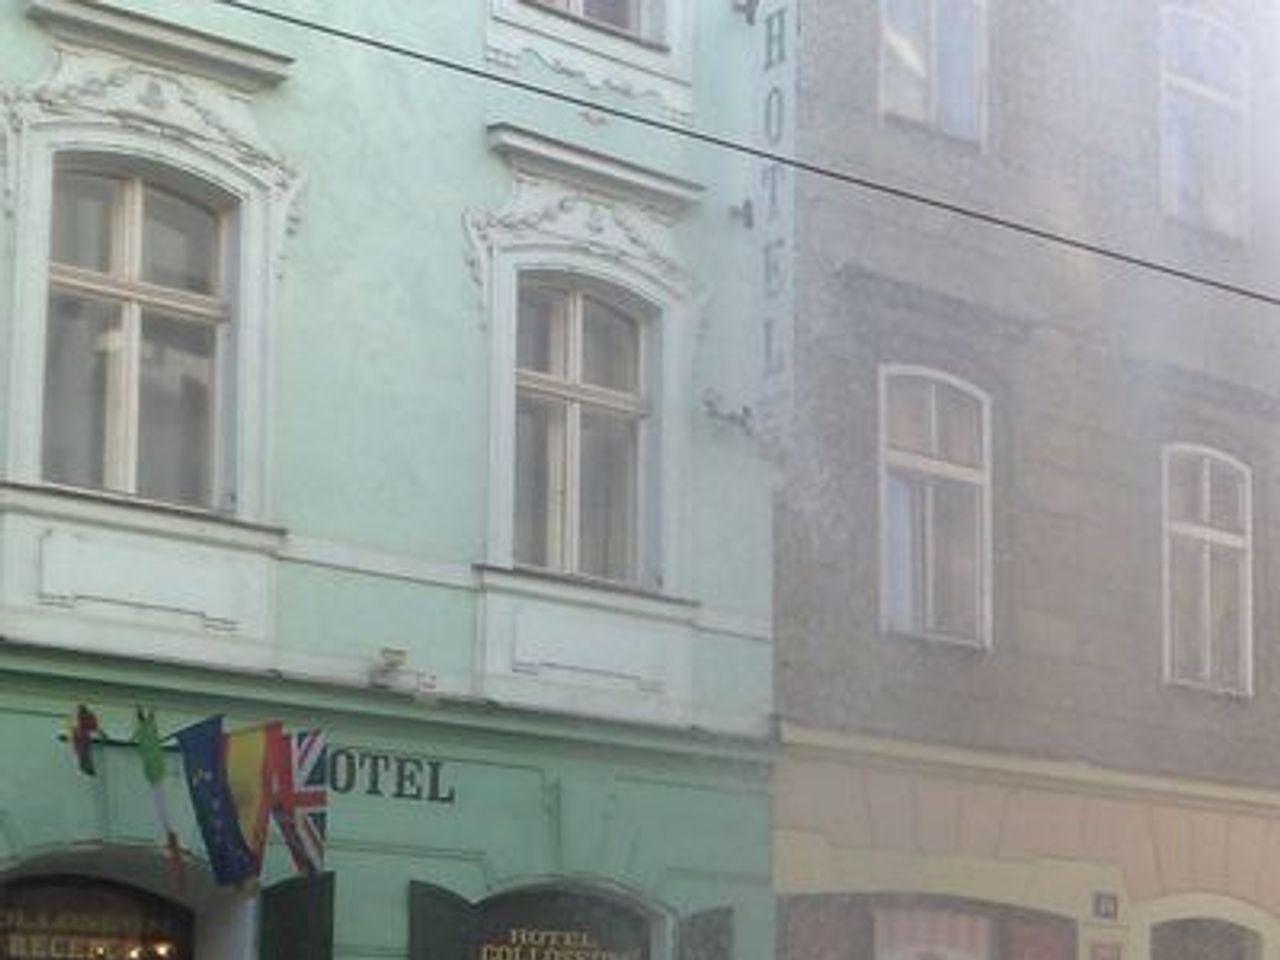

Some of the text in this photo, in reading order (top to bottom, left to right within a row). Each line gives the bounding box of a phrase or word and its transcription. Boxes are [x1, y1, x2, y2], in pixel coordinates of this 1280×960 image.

[764, 8, 786, 378] HOTEL
[328, 748, 456, 803] OTEL
[511, 928, 594, 945] HOTEL
